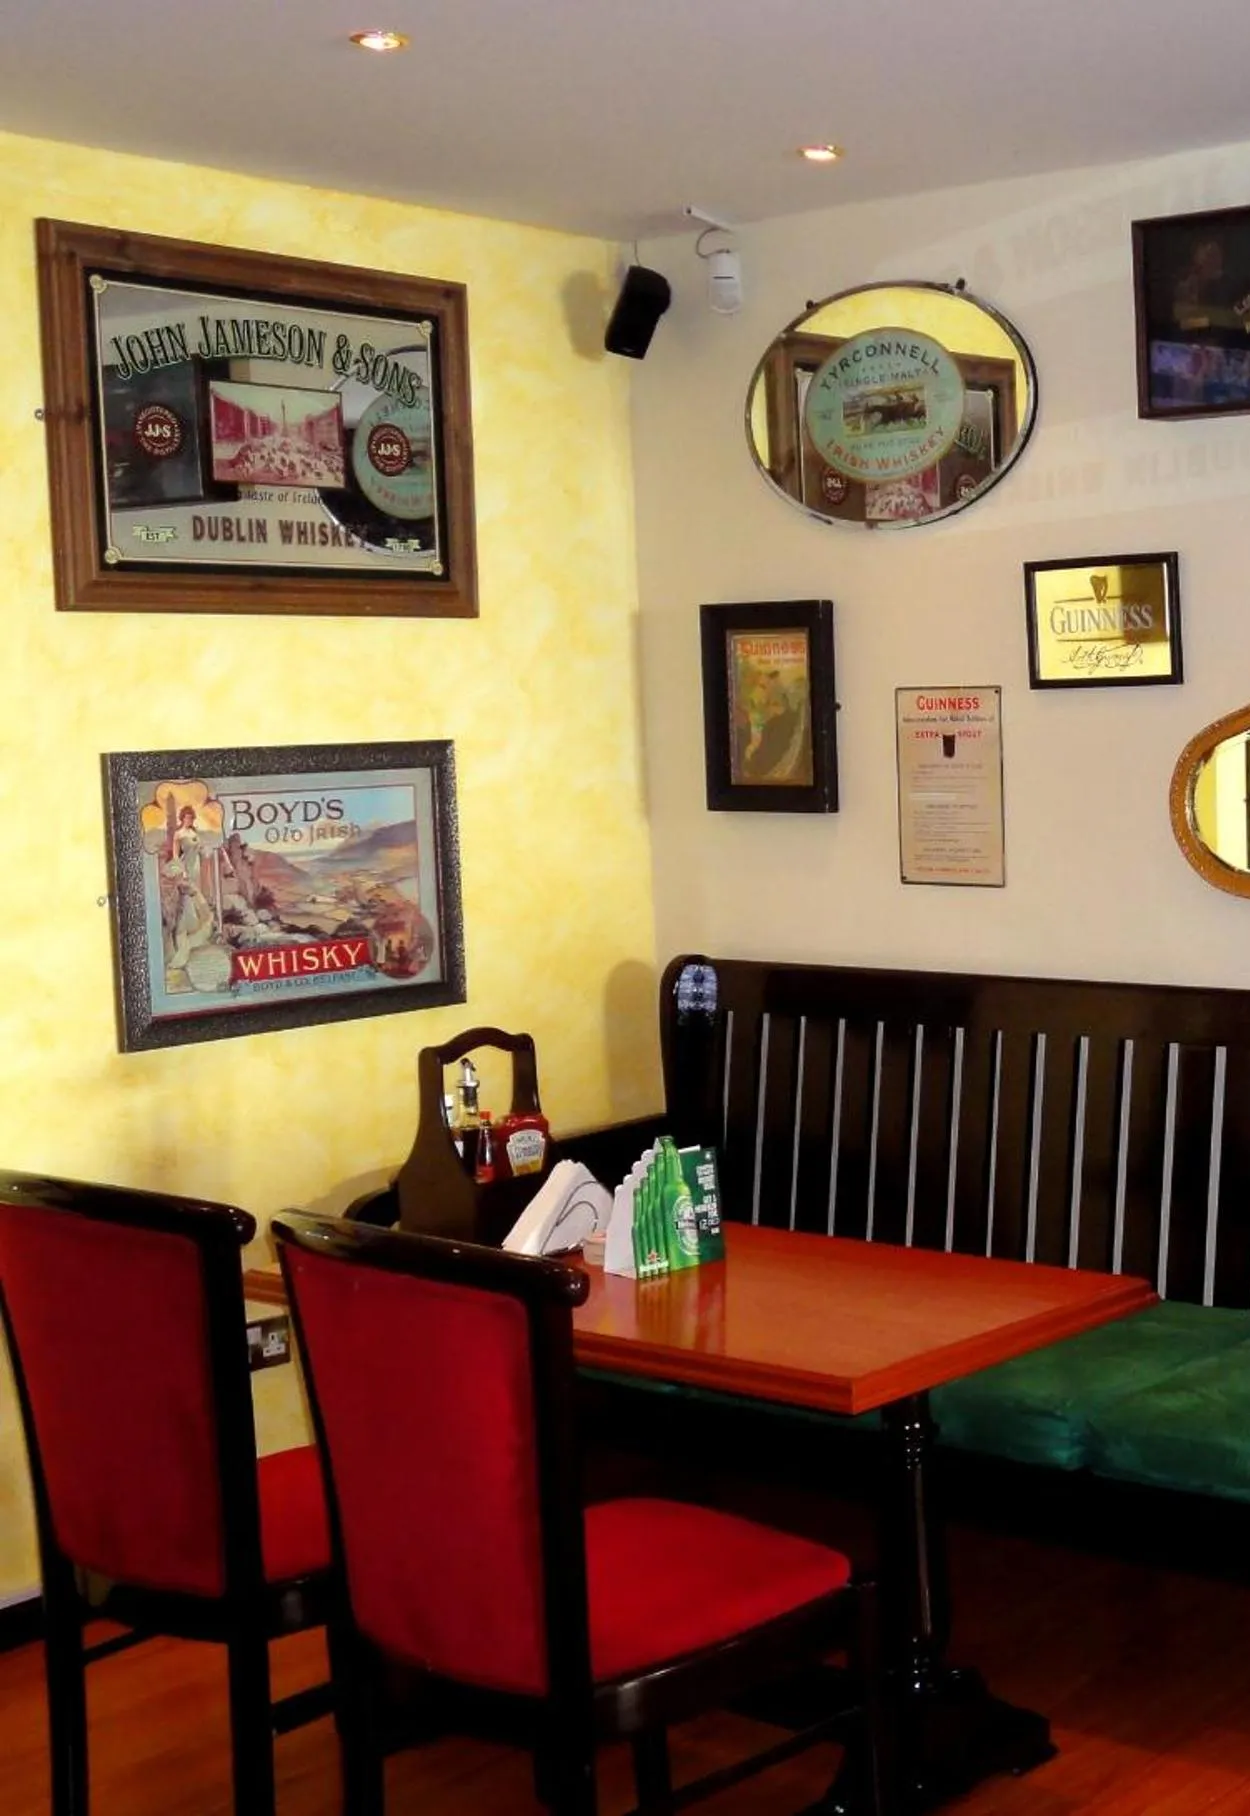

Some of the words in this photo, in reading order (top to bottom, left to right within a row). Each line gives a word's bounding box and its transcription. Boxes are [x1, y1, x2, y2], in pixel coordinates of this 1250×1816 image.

[110, 323, 192, 380] JOHN
[197, 316, 327, 368] JAMESON
[332, 334, 352, 377] &
[354, 342, 422, 408] SONS
[192, 515, 268, 544] DUBLIN
[1050, 603, 1154, 636] GUINNESS
[916, 694, 981, 711] GUINNESS
[231, 797, 345, 831] BOYD'S
[237, 943, 365, 977] WHISKY
